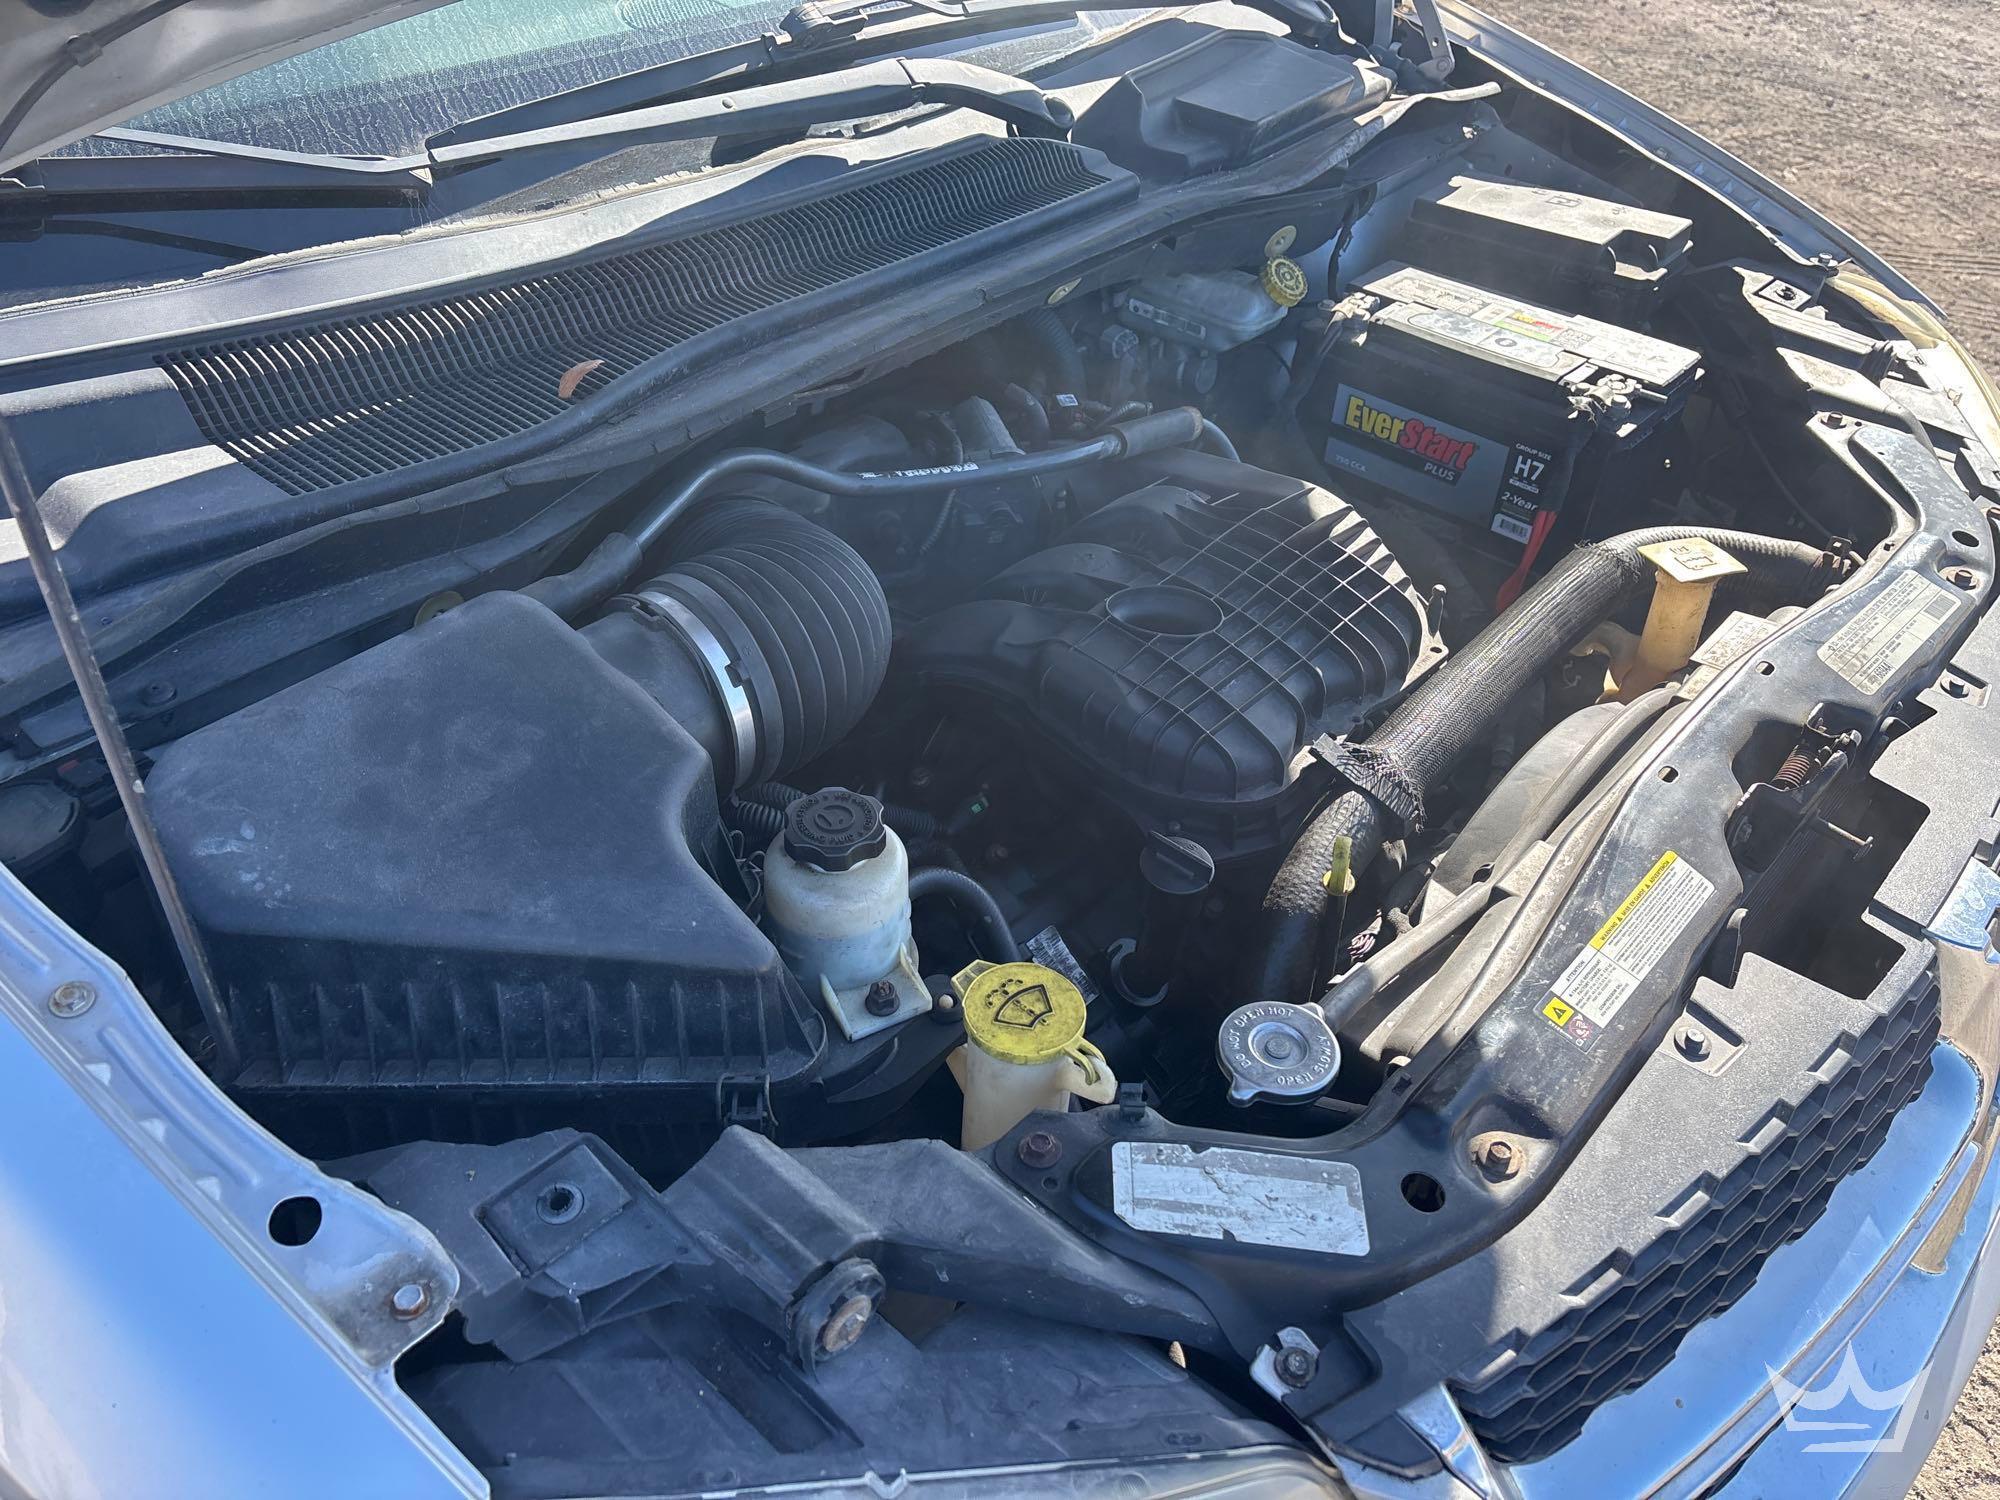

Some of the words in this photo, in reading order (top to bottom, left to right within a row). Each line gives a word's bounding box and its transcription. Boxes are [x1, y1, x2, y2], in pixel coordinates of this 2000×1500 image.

[1346, 396, 1476, 471] EverStart
[1515, 442, 1538, 455] GROUP
[1538, 450, 1552, 461] SIZE
[1424, 462, 1456, 482] PLUS
[1513, 455, 1545, 481] H7
[1501, 491, 1539, 511] 2-Year
[1600, 921, 1618, 941] WARNING
[1565, 960, 1585, 982] ATTENTION
[1235, 1007, 1265, 1028] OPEN
[1268, 1006, 1294, 1017] HOT
[1228, 1028, 1241, 1050] NOT
[1235, 1053, 1252, 1069] DO
[1276, 1072, 1314, 1086] OPEN
[1313, 1034, 1333, 1074] SLOWLY
